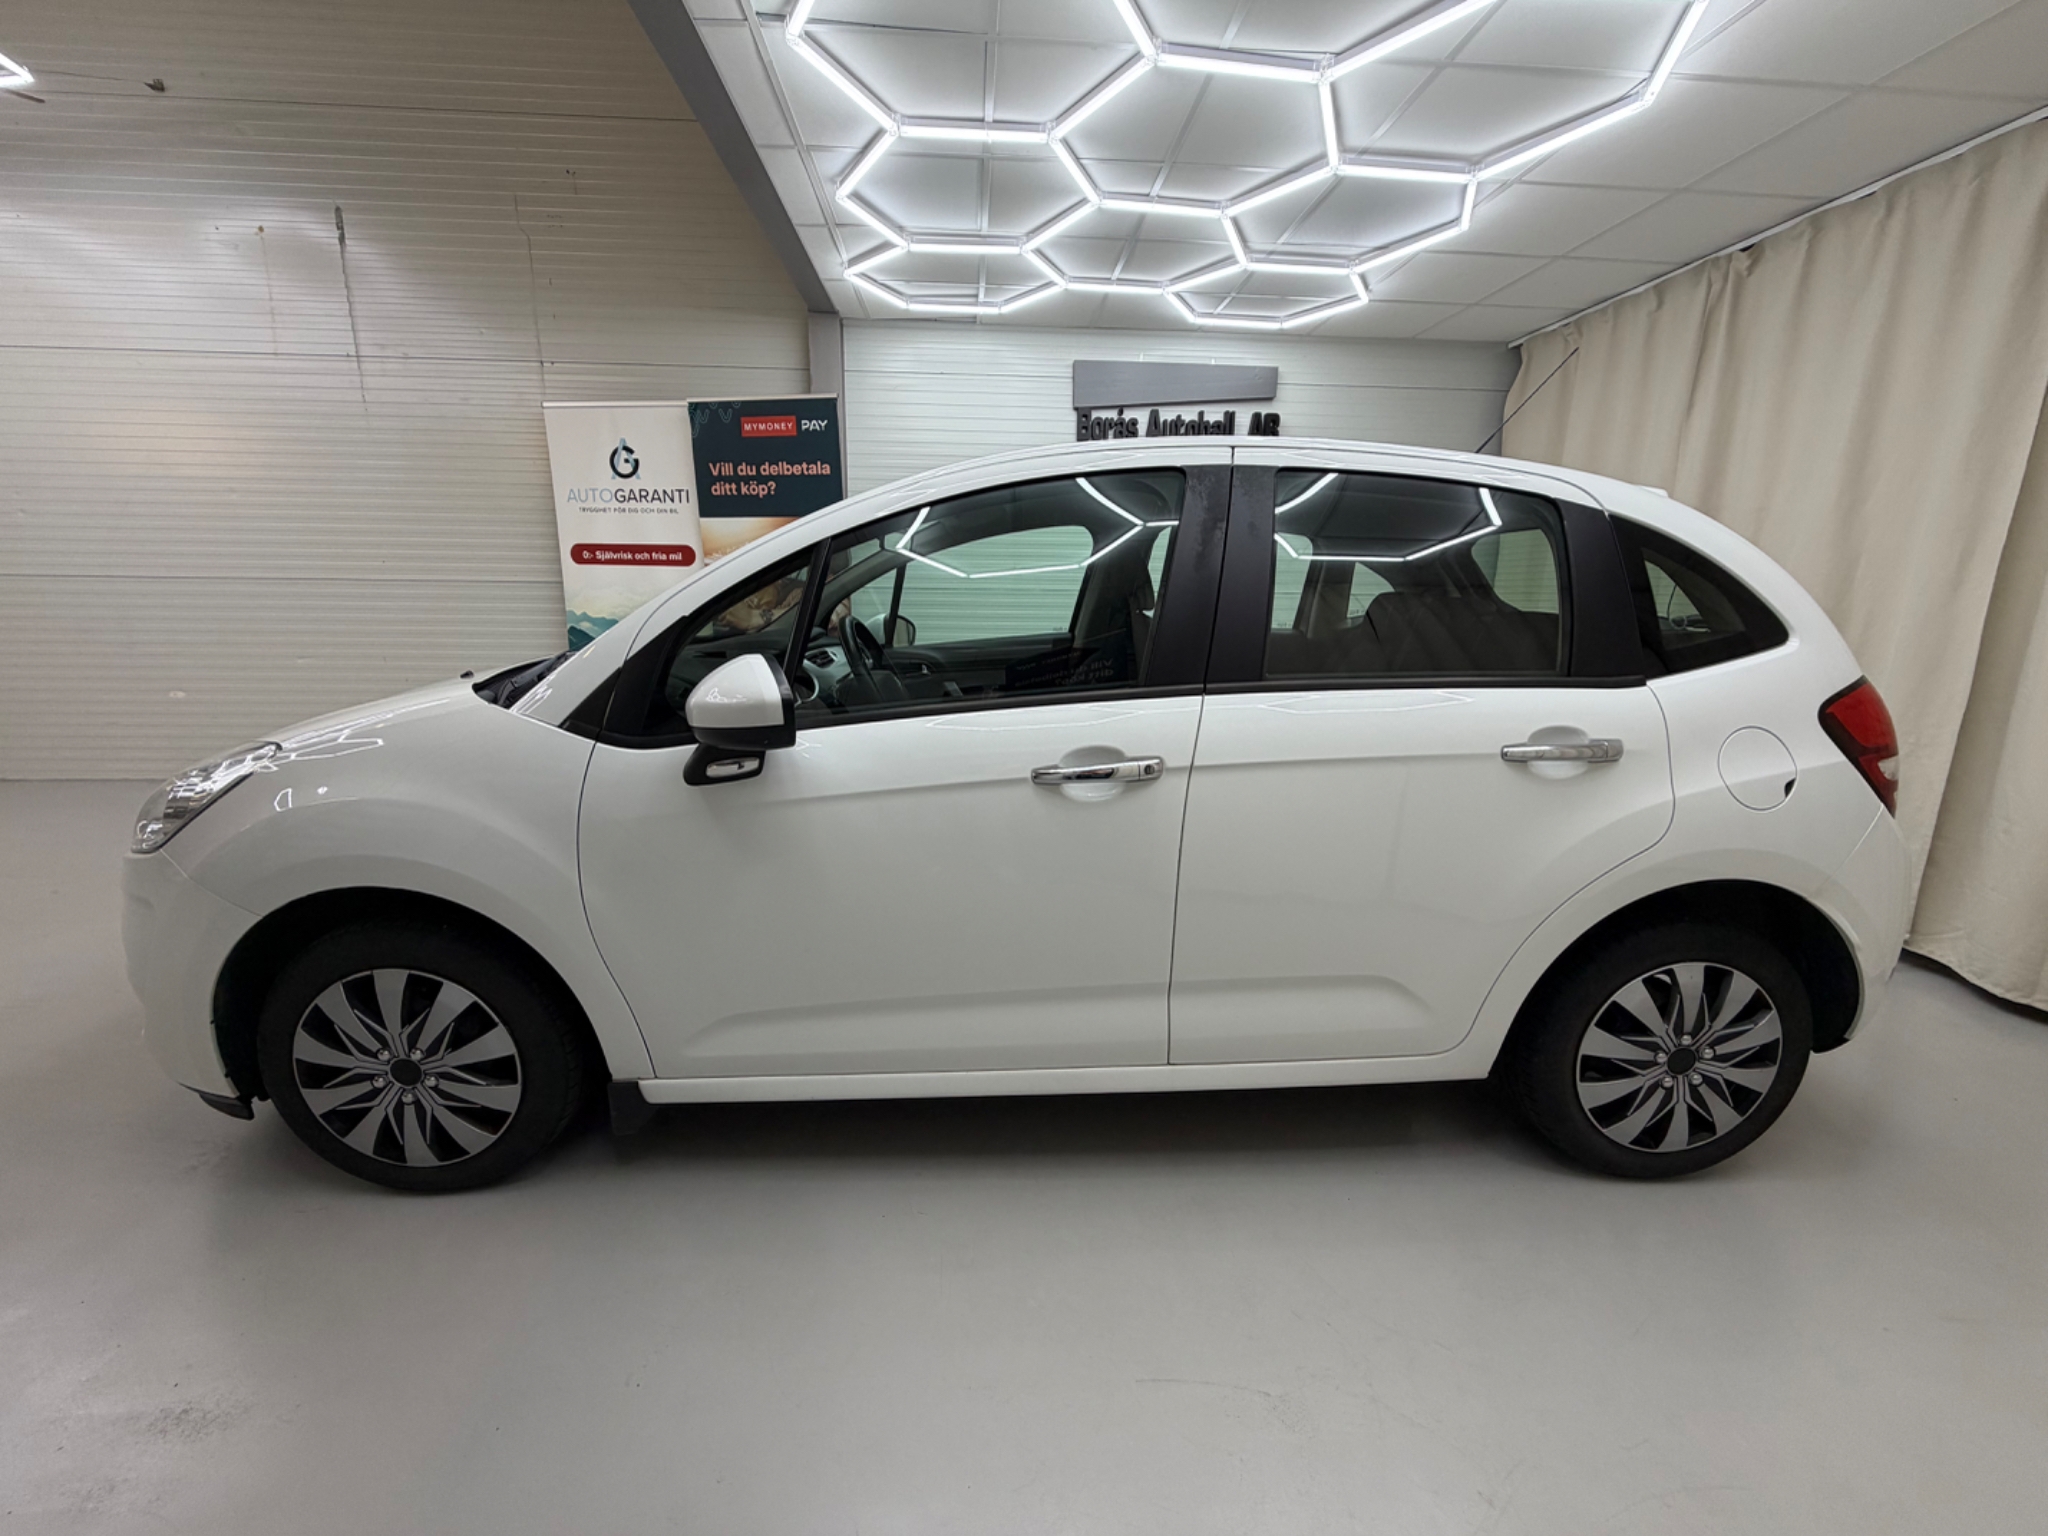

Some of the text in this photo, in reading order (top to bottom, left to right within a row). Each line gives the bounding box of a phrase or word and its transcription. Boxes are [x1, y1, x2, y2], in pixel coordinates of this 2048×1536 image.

[743, 420, 828, 432] MYMONEY PAY
[1247, 411, 1281, 437] AB
[708, 461, 831, 476] Vill du delbetala
[567, 488, 690, 504] AUTOGARANTI
[711, 481, 777, 499] ditt köp?
[595, 550, 633, 562] Självrisk
[634, 551, 650, 561] och
[651, 551, 667, 561] fria
[668, 551, 683, 561] mil
